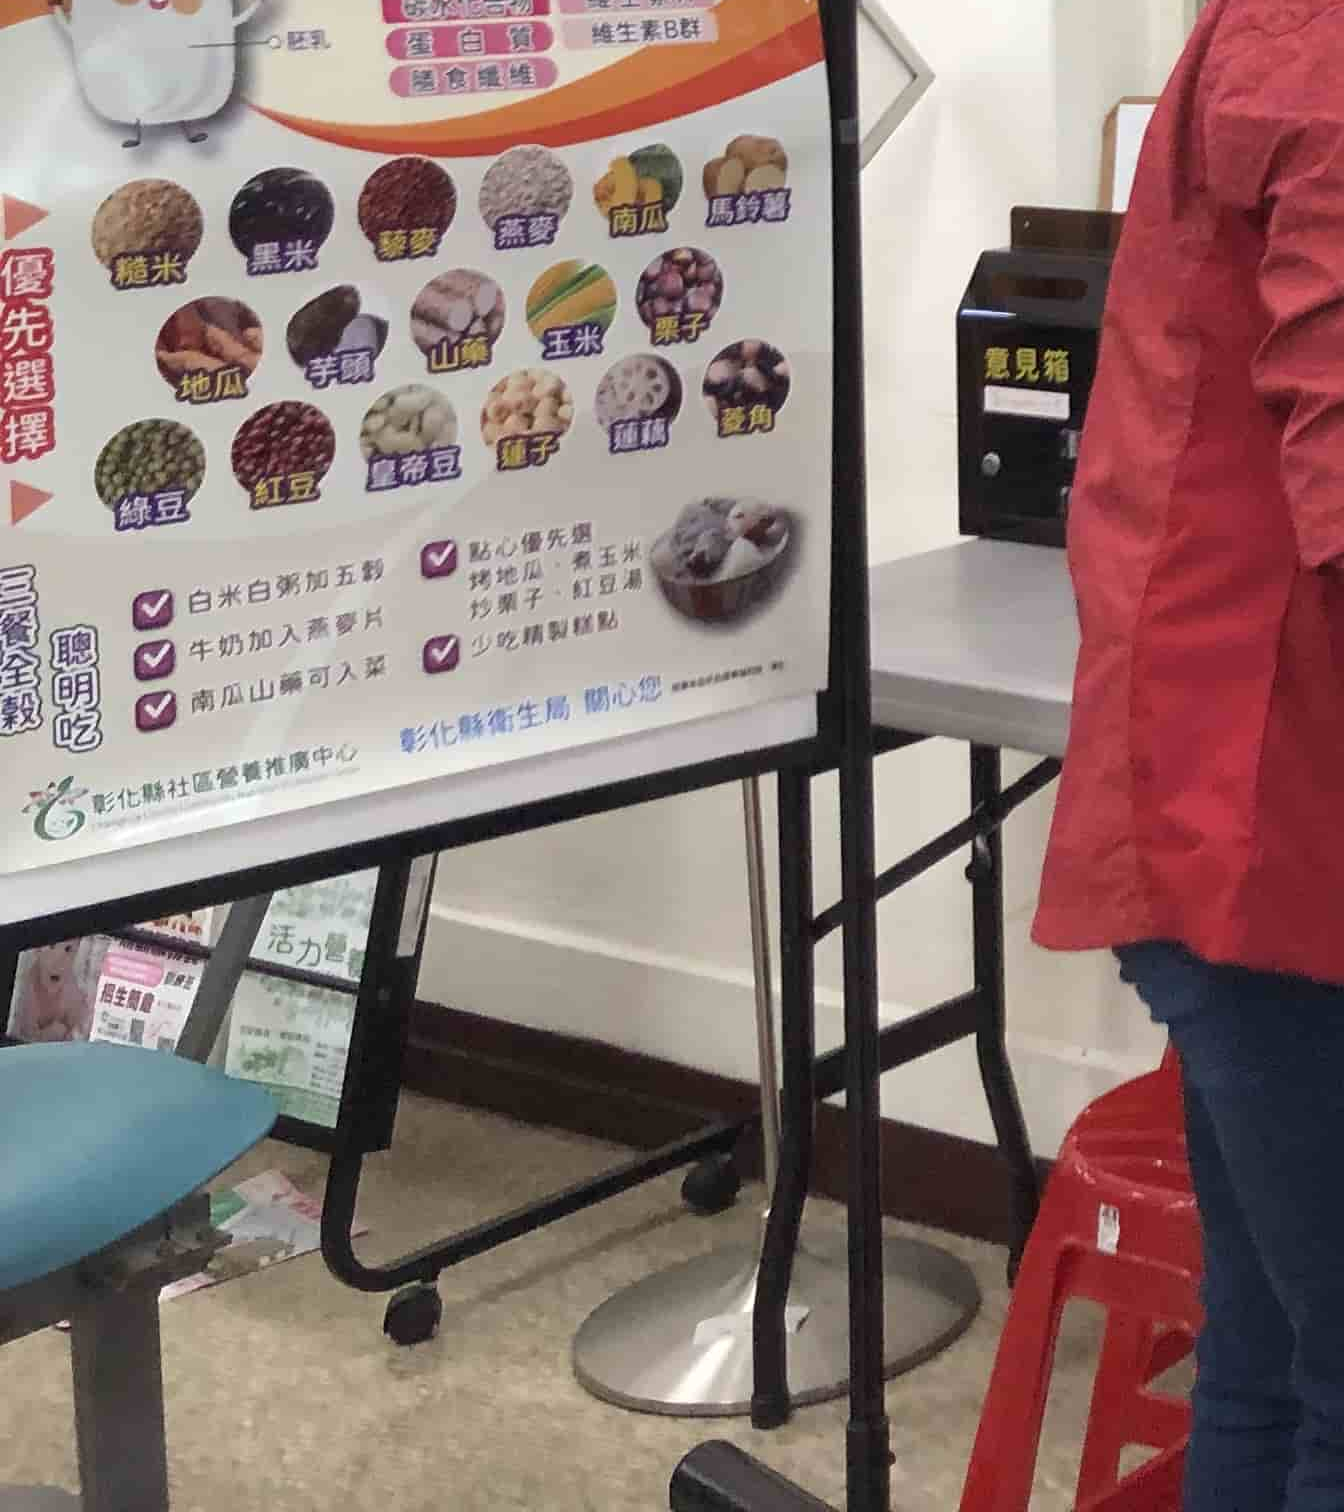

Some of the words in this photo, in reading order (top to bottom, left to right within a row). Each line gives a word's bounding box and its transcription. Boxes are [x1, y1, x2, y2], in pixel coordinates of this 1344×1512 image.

[407, 24, 535, 56] 蛋白質
[591, 17, 703, 45] 維生素B群
[410, 60, 538, 92] 膳食纖維
[115, 252, 184, 287] 糙米
[251, 239, 316, 274] 黑米
[496, 215, 556, 247] 燕麥
[611, 201, 668, 235] 南瓜
[706, 189, 791, 226] 馬鈴薯
[2, 251, 51, 460] 優先選擇
[179, 369, 246, 402] 地瓜
[308, 350, 375, 385] 芋頭
[430, 337, 491, 370] 山藥
[545, 327, 601, 357] 玉米
[654, 314, 707, 345] 栗子
[984, 347, 1071, 383] 意見箱
[119, 490, 187, 527] 綠豆
[254, 473, 318, 507] 紅豆
[370, 448, 460, 489] 皇帝豆
[499, 435, 559, 468] 蓮子
[611, 419, 669, 452] 蓮藕
[720, 407, 774, 435] 菱角
[468, 521, 593, 563] 點心優先選
[189, 558, 384, 616] 白米白粥加五穀
[0, 568, 40, 731] 三餐全穀
[190, 606, 384, 662] 牛奶加入燕麥片
[471, 609, 619, 658] 少吃精製糕點
[55, 630, 99, 749] 聰明吃
[191, 654, 389, 715] 南瓜山藥可入菜
[400, 694, 571, 756] 彰化縣衛生局
[583, 673, 663, 714] 關心您
[93, 742, 359, 816] 彰化縣社區營養推廣中心
